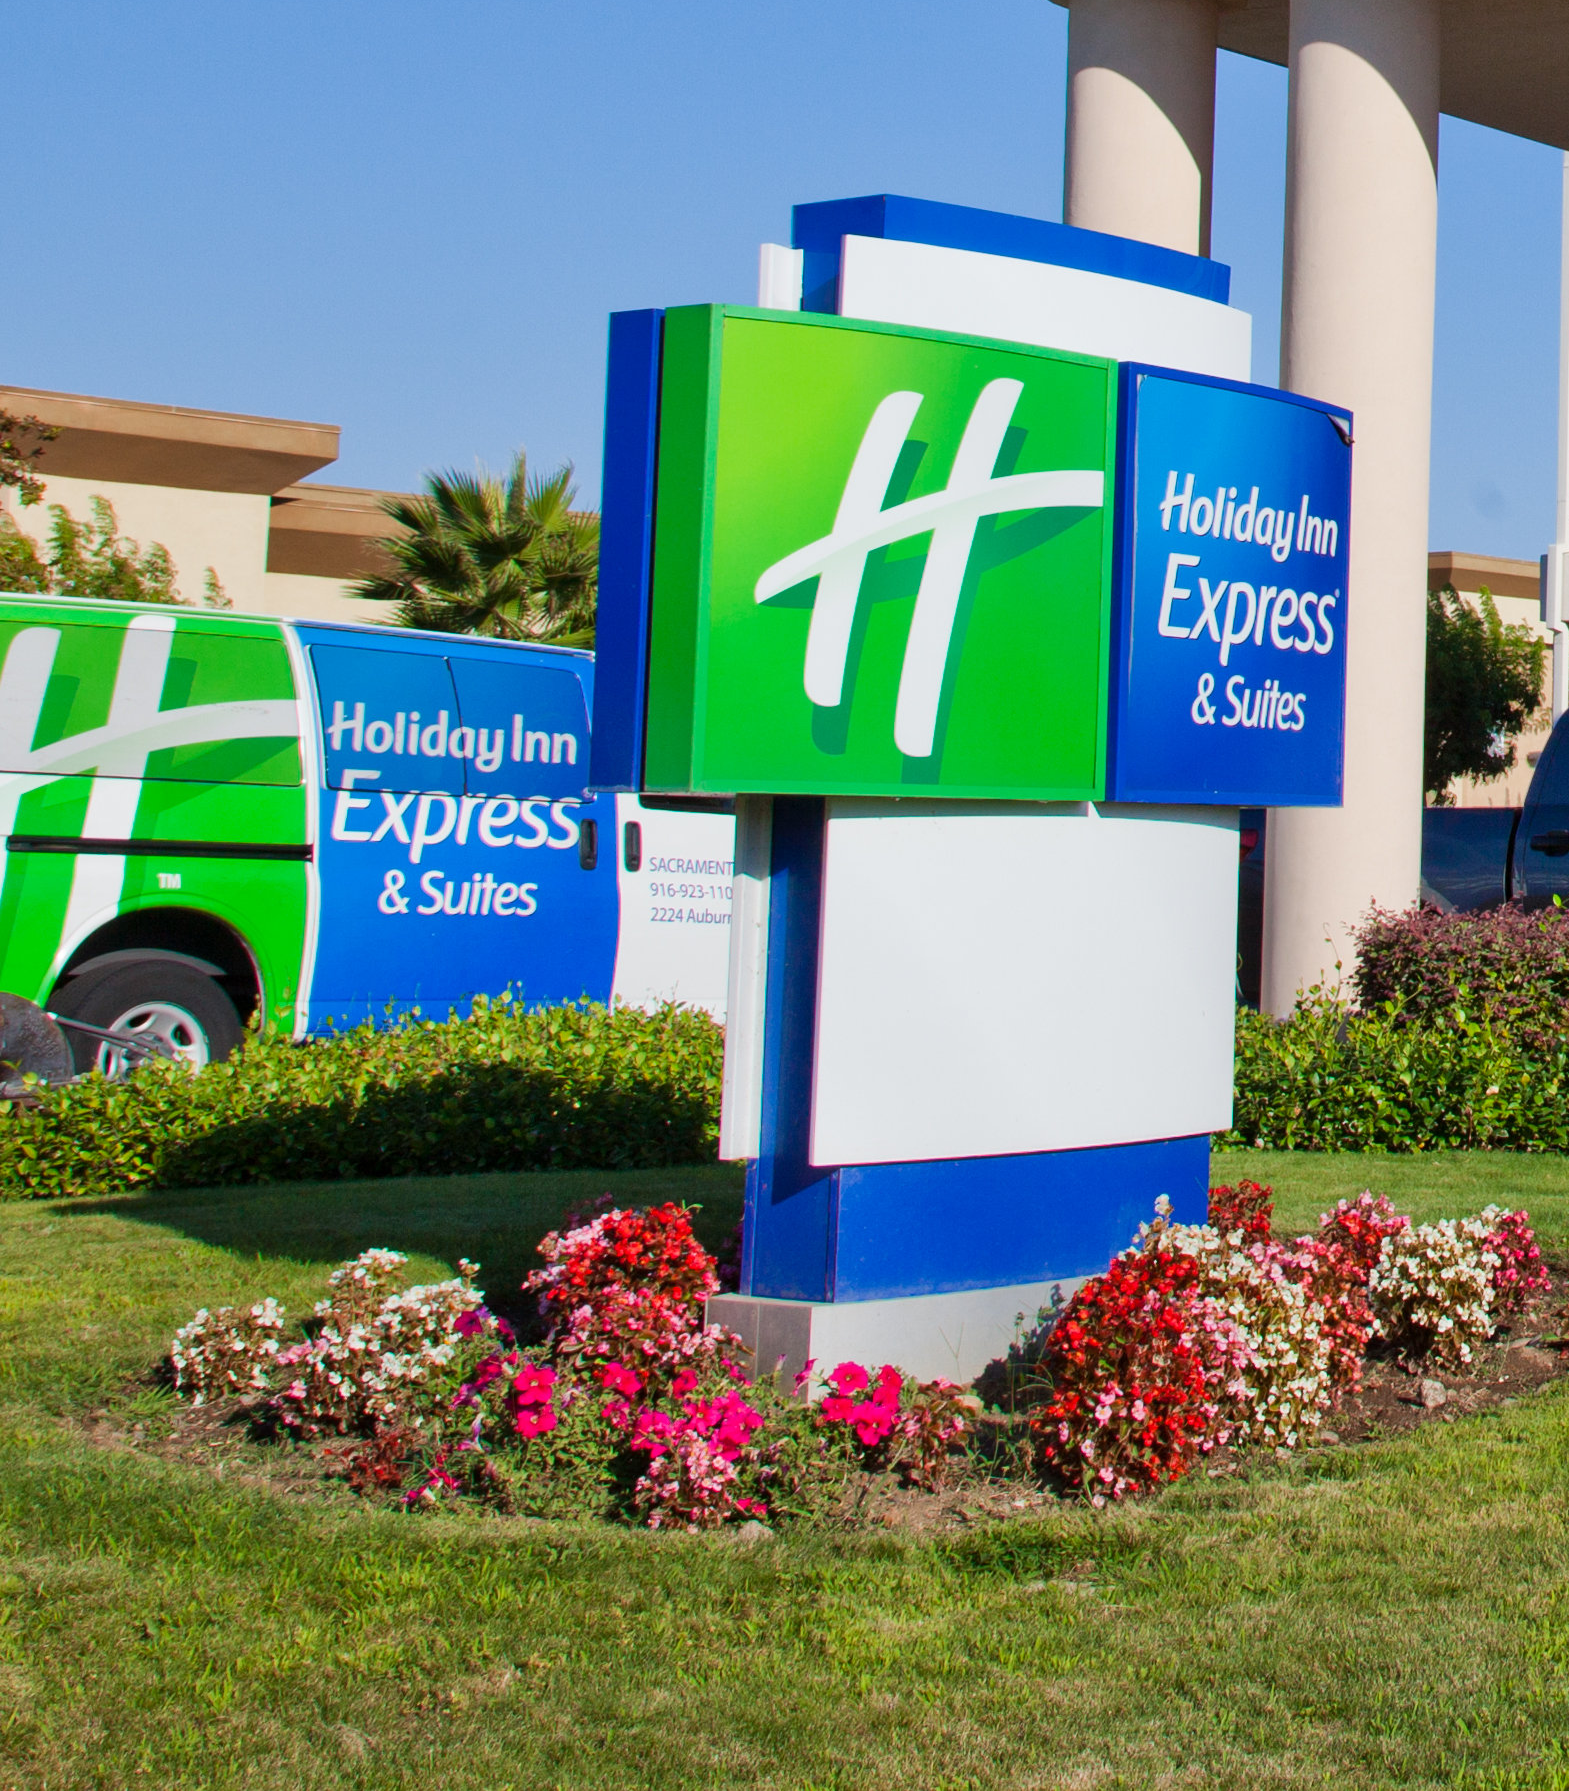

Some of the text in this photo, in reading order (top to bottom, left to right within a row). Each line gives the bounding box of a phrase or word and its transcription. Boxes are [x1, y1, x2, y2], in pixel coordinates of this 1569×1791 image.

[1159, 469, 1338, 563] Holiday Inn
[1158, 552, 1337, 667] Express
[1191, 672, 1307, 731] & Suites
[326, 700, 578, 773] Holiday Inn
[331, 768, 583, 864] Express
[156, 873, 182, 889] TM
[377, 869, 538, 916] & Suites
[649, 857, 734, 875] SACRAMENT
[650, 882, 733, 900] 916-923-110
[650, 907, 683, 923] 2224
